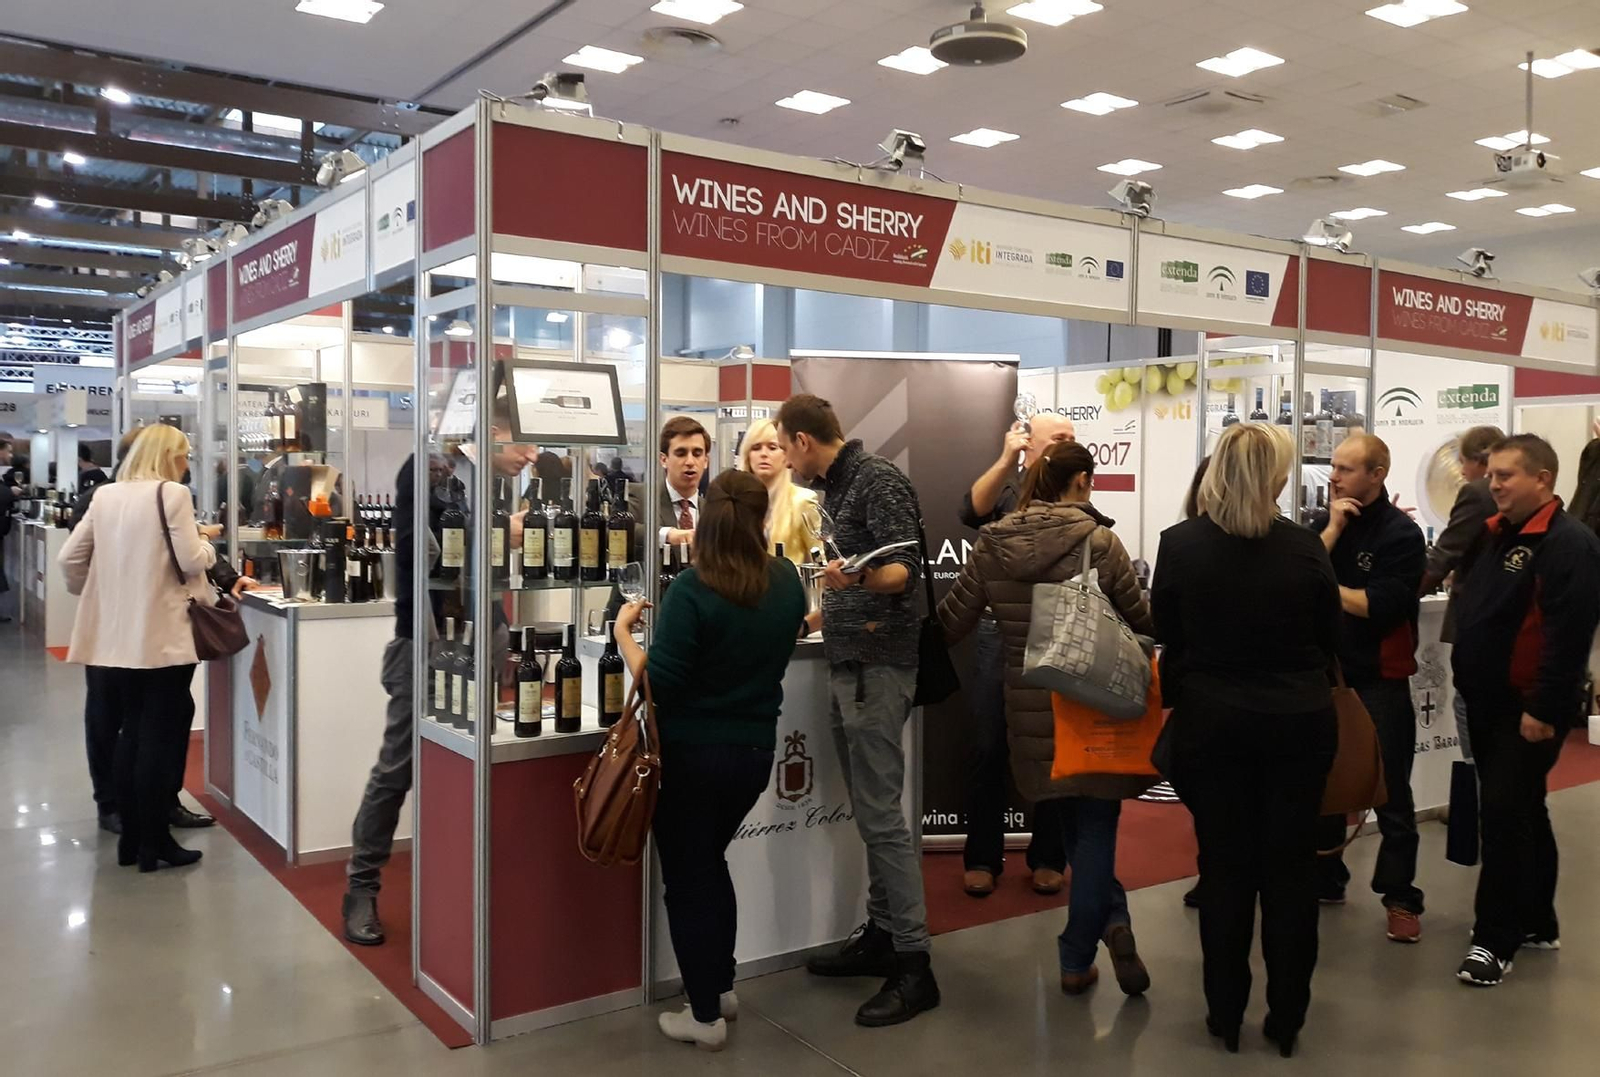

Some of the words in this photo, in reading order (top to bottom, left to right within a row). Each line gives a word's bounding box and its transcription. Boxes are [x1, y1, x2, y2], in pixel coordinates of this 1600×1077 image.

[671, 173, 764, 216] WINES
[772, 191, 828, 225] AND
[836, 202, 924, 239] SHERRY
[672, 209, 748, 243] WINES
[756, 221, 817, 253] FROM
[824, 232, 890, 262] CADIZ
[970, 239, 991, 265] iti
[995, 250, 1033, 263] INTEGRADA
[1161, 264, 1198, 279] extenda
[1392, 286, 1433, 311] WINES
[1436, 294, 1462, 315] AND
[1465, 299, 1506, 322] SHERRY
[1439, 387, 1497, 405] extenda
[1172, 400, 1191, 420] iti
[1086, 441, 1131, 466] 2017
[921, 809, 958, 825] wina
